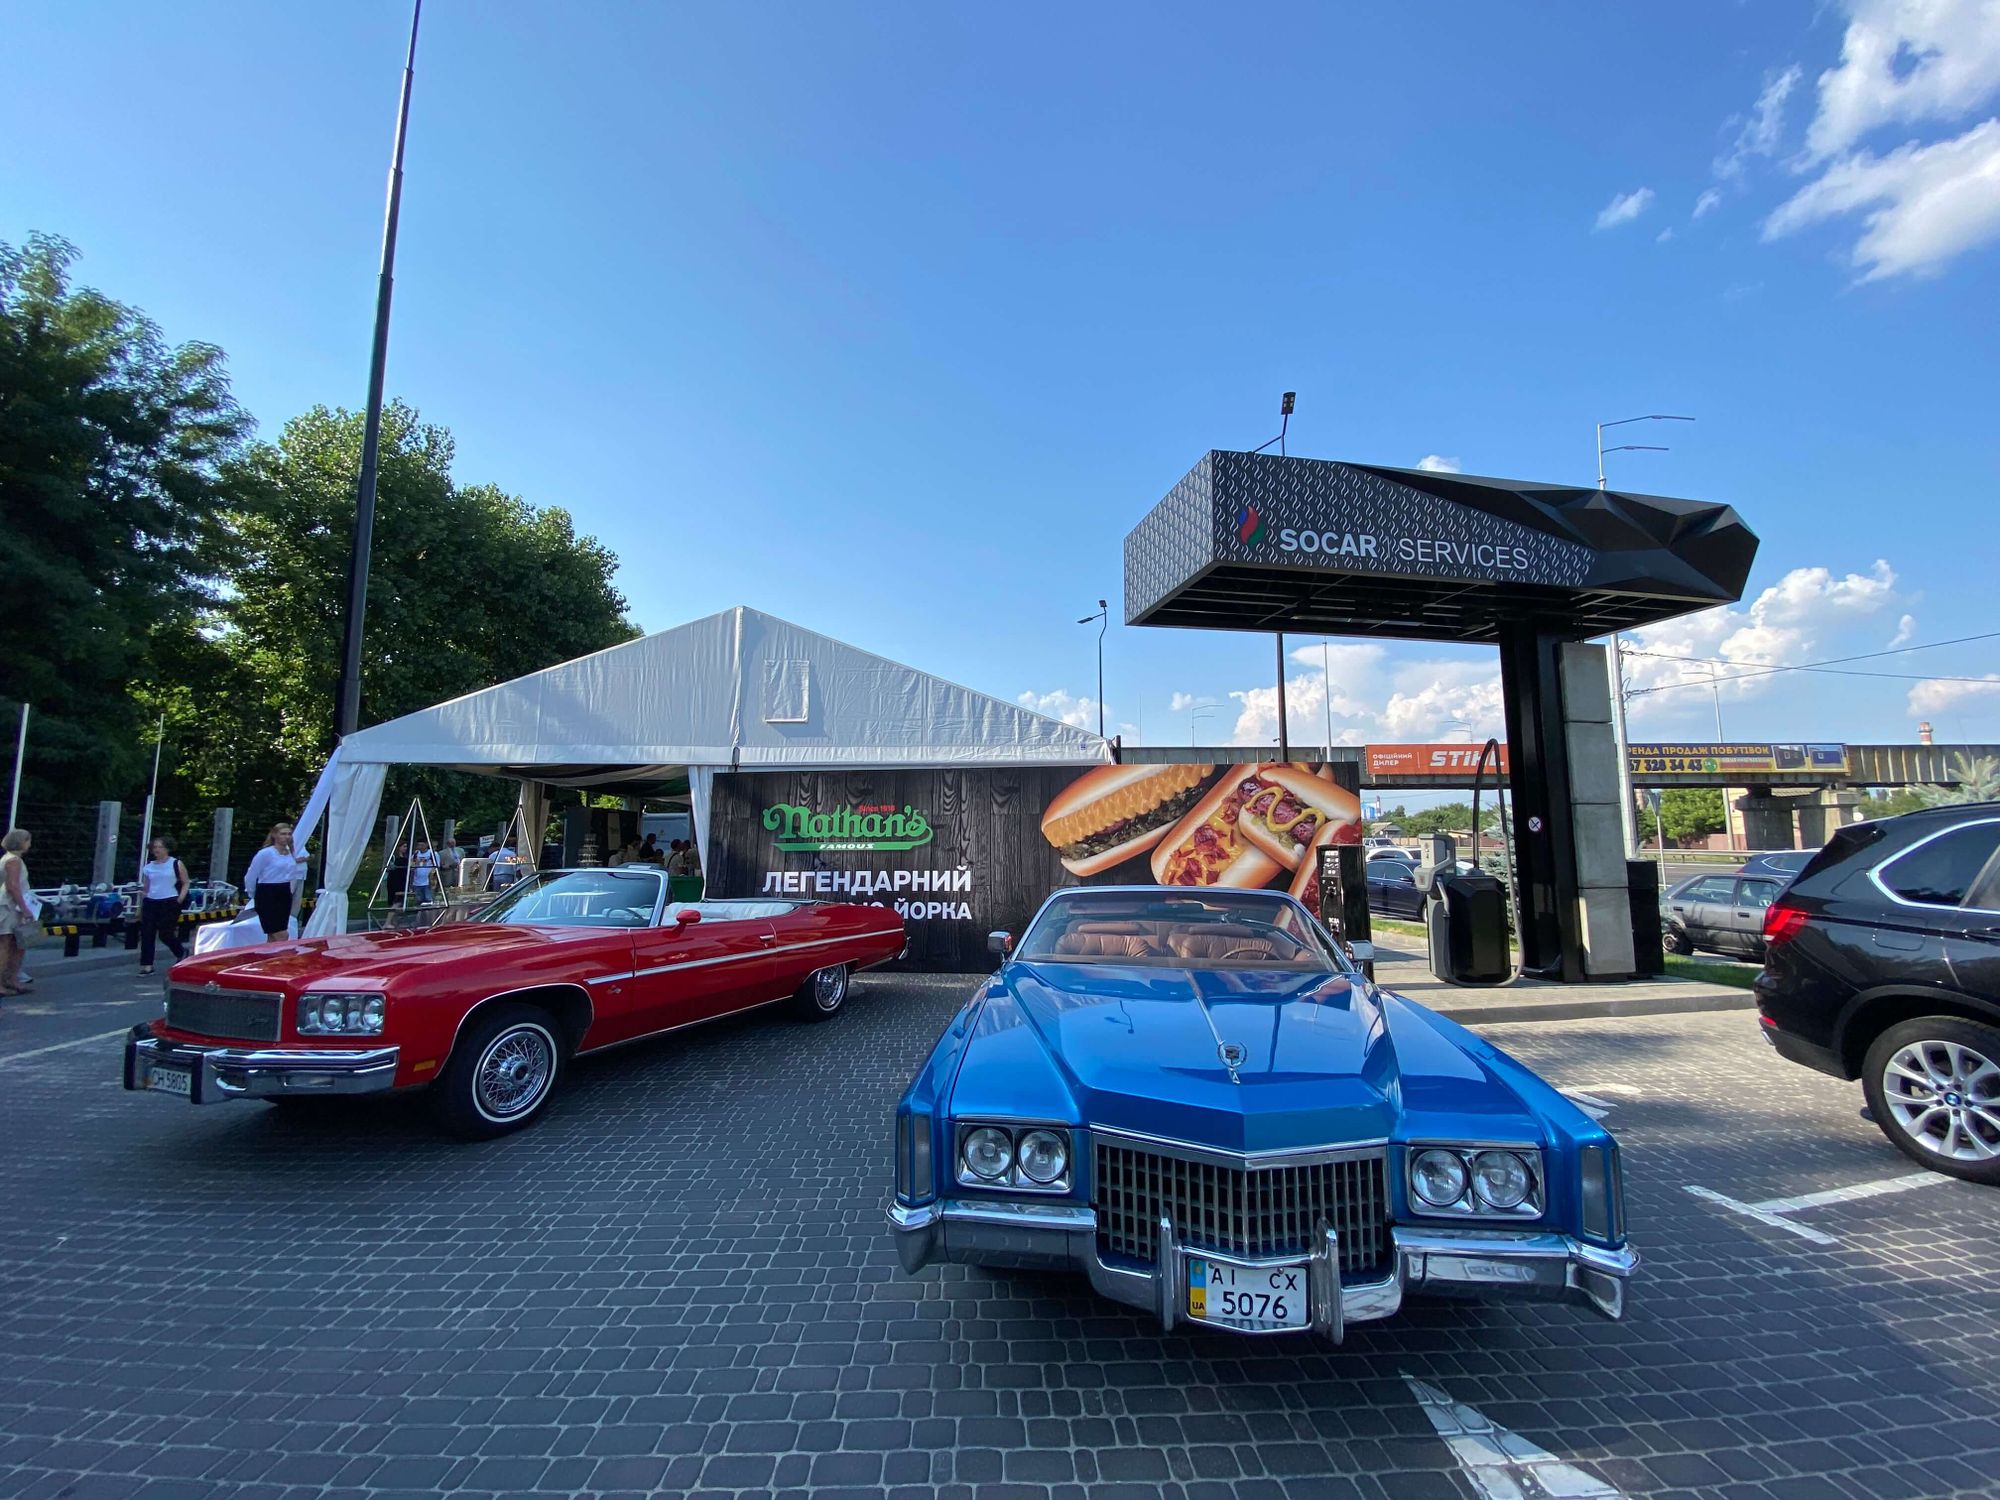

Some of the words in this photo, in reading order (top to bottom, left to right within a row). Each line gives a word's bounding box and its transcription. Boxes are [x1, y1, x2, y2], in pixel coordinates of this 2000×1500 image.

[1279, 528, 1378, 558] SOCAR
[1399, 537, 1529, 570] SERVICES
[1662, 747, 1708, 755] ПРОДАЖ
[1711, 747, 1769, 755] ПОБУТІВОК
[1670, 759, 1685, 771] 34
[1687, 759, 1702, 771] 43
[763, 803, 930, 839] Nathan's
[762, 865, 971, 896] ЛЕГЕНДАРНИЙ
[896, 898, 972, 920] ЙОРКА
[1211, 1268, 1235, 1285] AI
[1269, 1273, 1297, 1291] CX
[1192, 1301, 1205, 1310] UA
[1222, 1291, 1288, 1319] 5076
